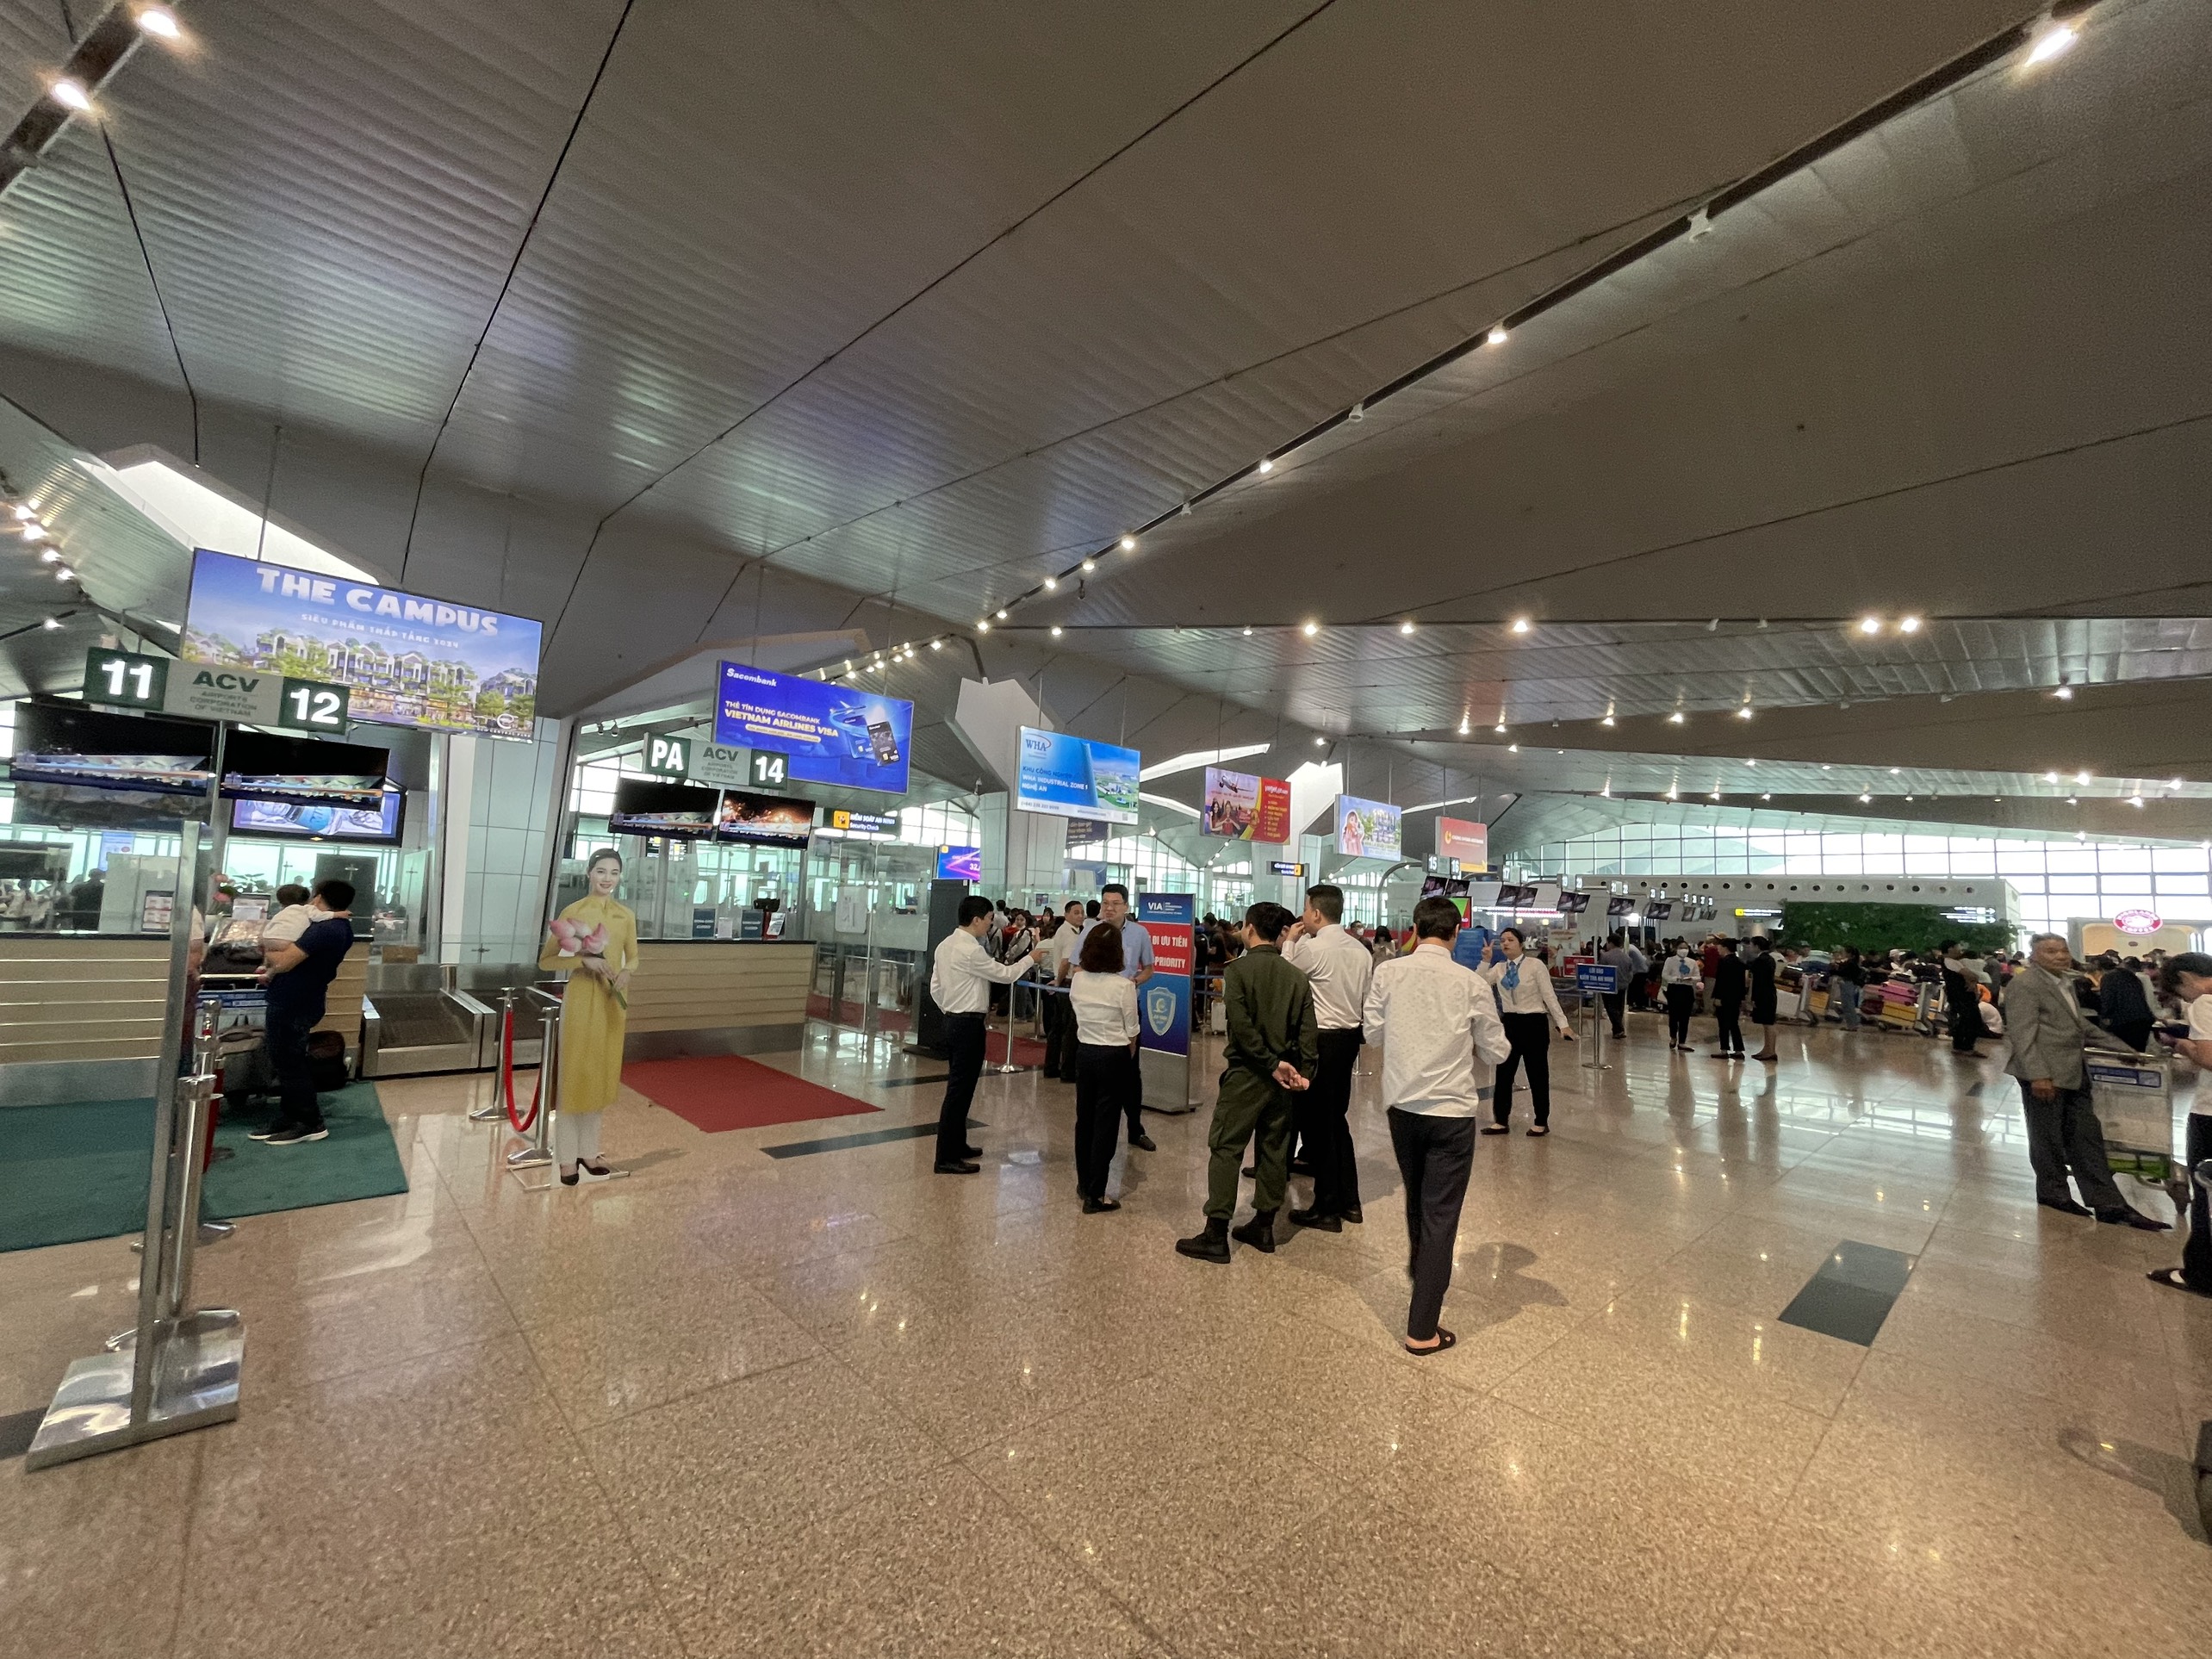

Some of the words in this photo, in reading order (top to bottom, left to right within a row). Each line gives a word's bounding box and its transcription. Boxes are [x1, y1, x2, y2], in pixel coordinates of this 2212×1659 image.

[257, 568, 336, 606] THE
[346, 588, 498, 637] CAMPUS
[101, 659, 154, 699] 11
[192, 670, 259, 692] ACV
[726, 668, 777, 687] Sacombank
[289, 688, 341, 724] 12
[724, 708, 771, 725] VIETNAM
[772, 718, 817, 733] AIRLINES
[817, 725, 839, 737] VISA
[776, 710, 821, 725] SACOMBANK
[1026, 739, 1047, 752] WHA
[650, 739, 685, 772] PA
[703, 747, 739, 762] ACV
[755, 755, 785, 784] 14
[1038, 777, 1069, 787] INDUSTRIAL
[1429, 855, 1438, 871] 15
[1451, 860, 1460, 873] 16
[1148, 902, 1163, 910] VIA
[1171, 935, 1188, 948] TIÊN
[1154, 956, 1185, 969] PRIORITY
